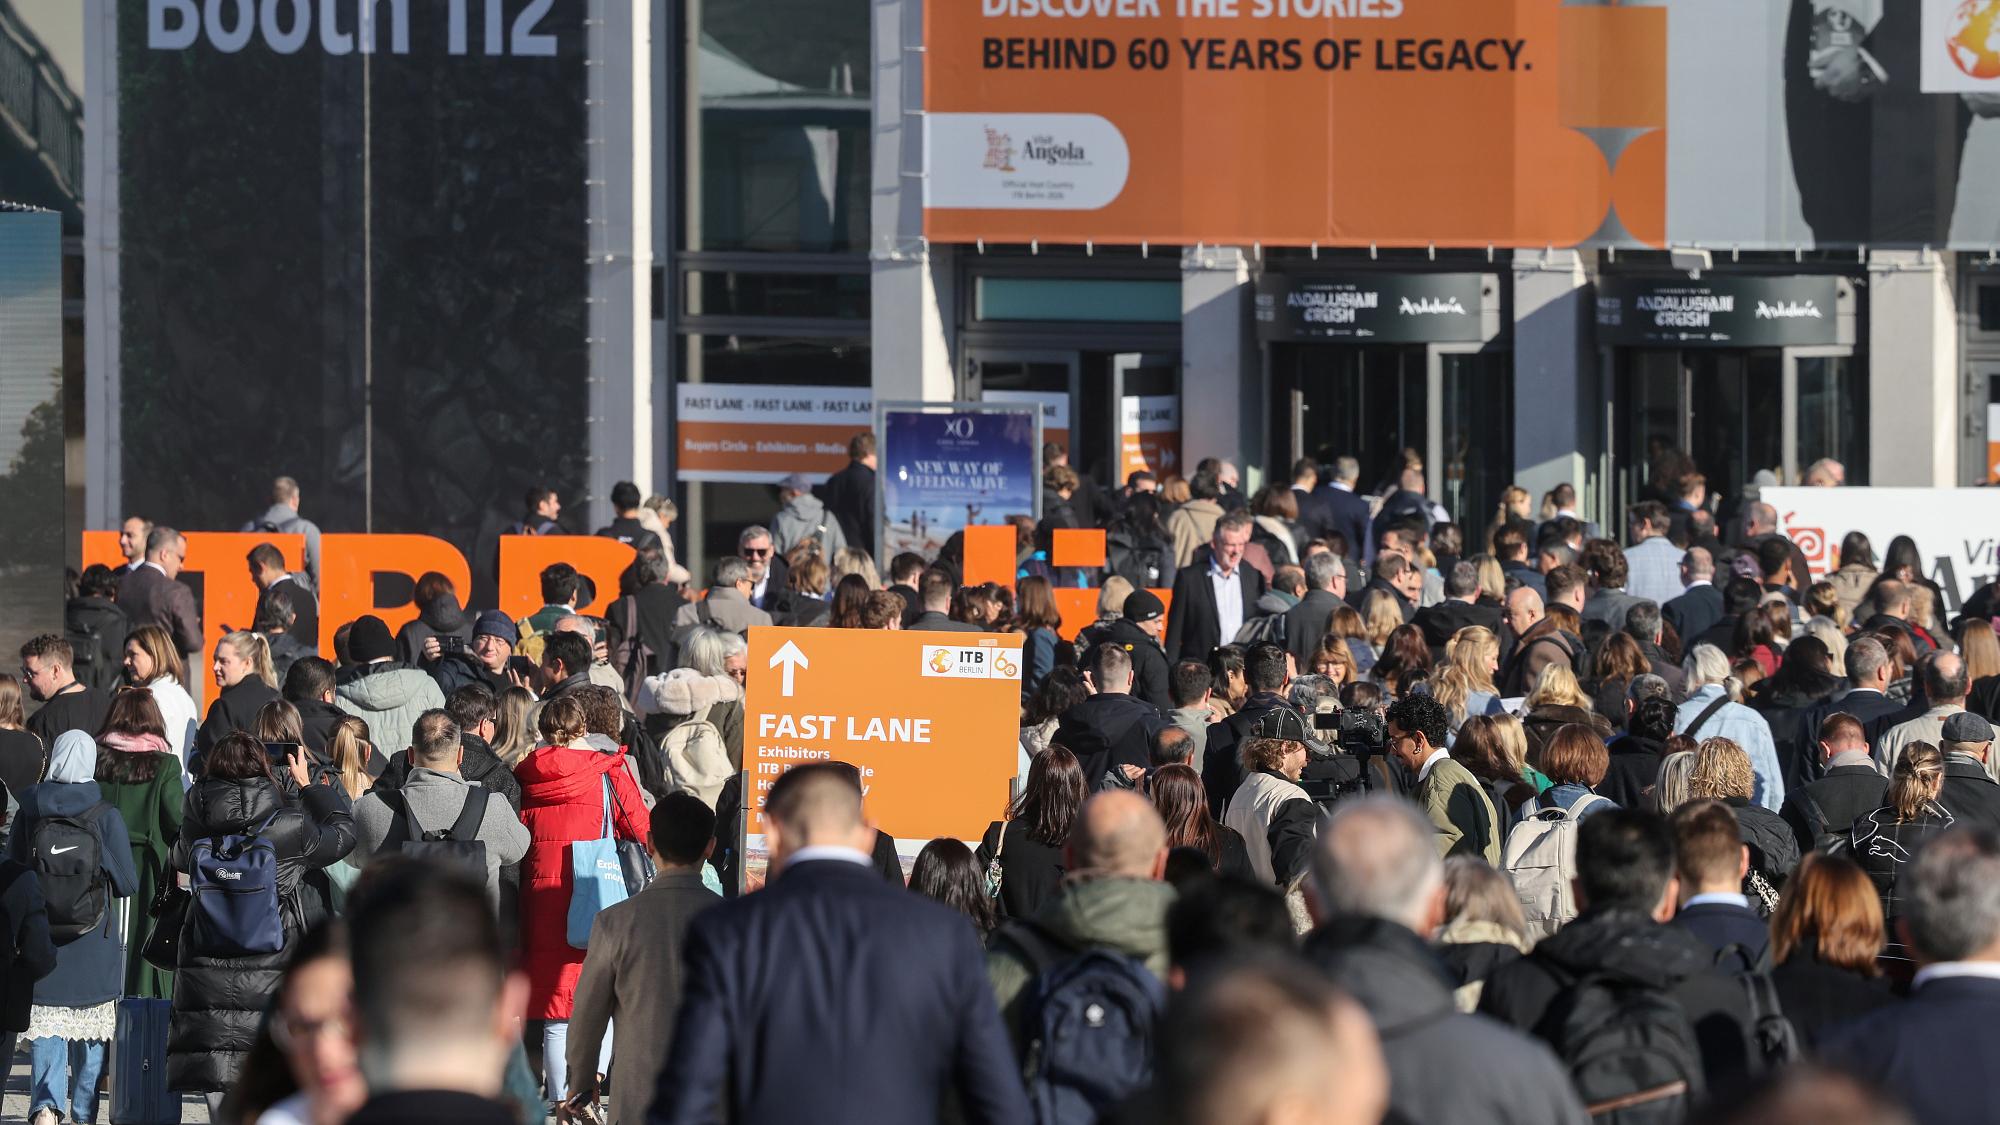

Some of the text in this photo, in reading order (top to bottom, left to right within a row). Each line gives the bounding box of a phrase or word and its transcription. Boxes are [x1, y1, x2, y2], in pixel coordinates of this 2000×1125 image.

[982, 37, 1532, 72] BEHIND 60 YEARS OF LEGACY.
[1022, 140, 1085, 165] Angola
[685, 397, 711, 410] FAST
[714, 399, 744, 411] LANE
[753, 399, 780, 411] FAST
[784, 400, 813, 412] LANE
[823, 401, 849, 413] FAST
[852, 402, 872, 413] LAN
[959, 651, 983, 663] ITB
[959, 666, 984, 674] BERLIN
[759, 714, 931, 743] FAST LANE
[758, 746, 831, 760] Exhibitors
[758, 762, 779, 774] ITB
